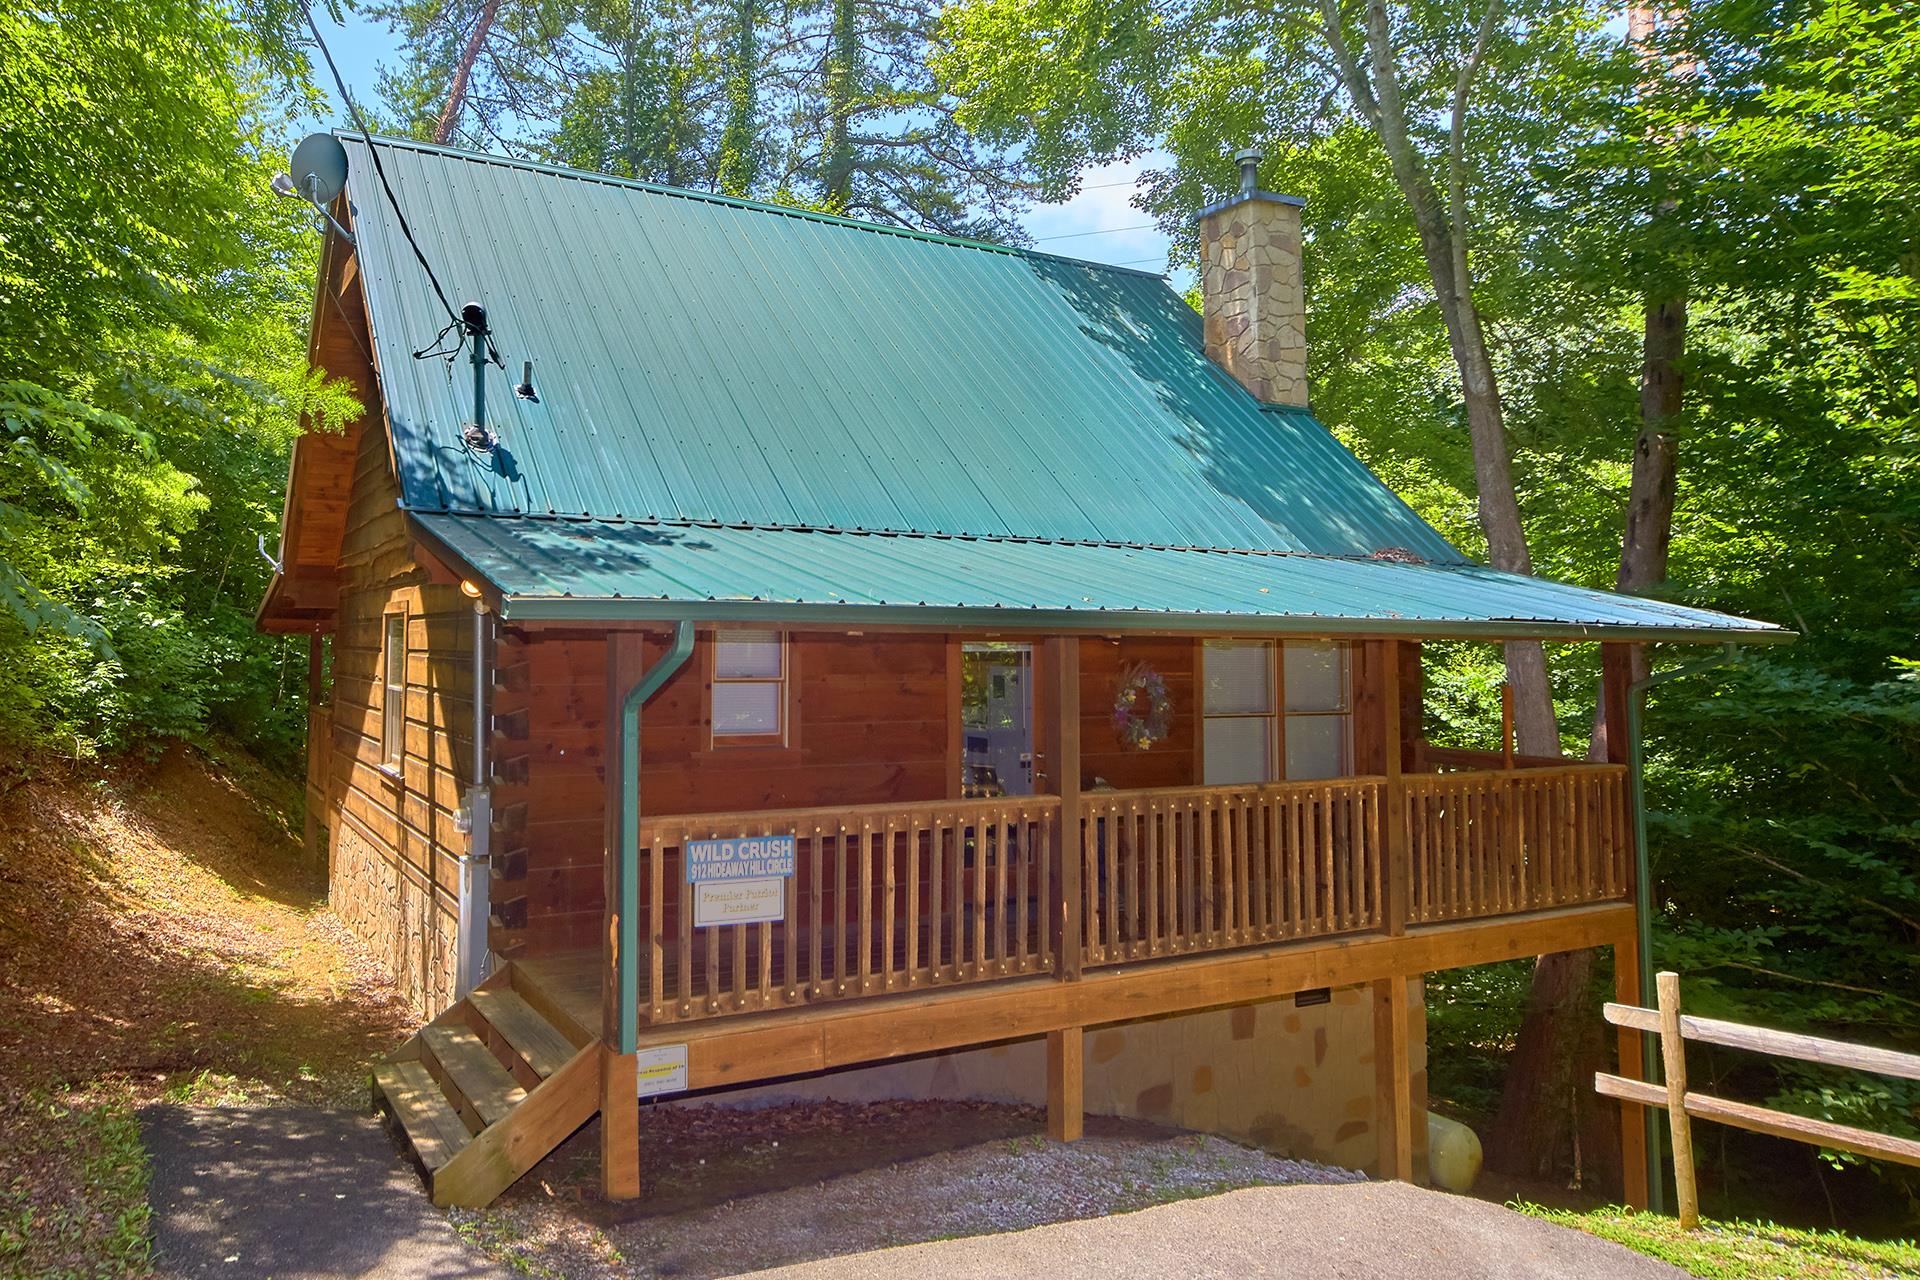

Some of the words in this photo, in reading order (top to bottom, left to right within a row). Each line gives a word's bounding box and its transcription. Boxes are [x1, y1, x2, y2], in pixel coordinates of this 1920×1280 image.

[690, 843, 735, 862] WILD
[738, 840, 792, 860] CRUSH
[691, 864, 706, 880] 912
[708, 861, 750, 878] HIDEAWAY
[750, 860, 767, 876] HILL
[767, 858, 793, 874] CIRCLE
[703, 891, 743, 902] Premier
